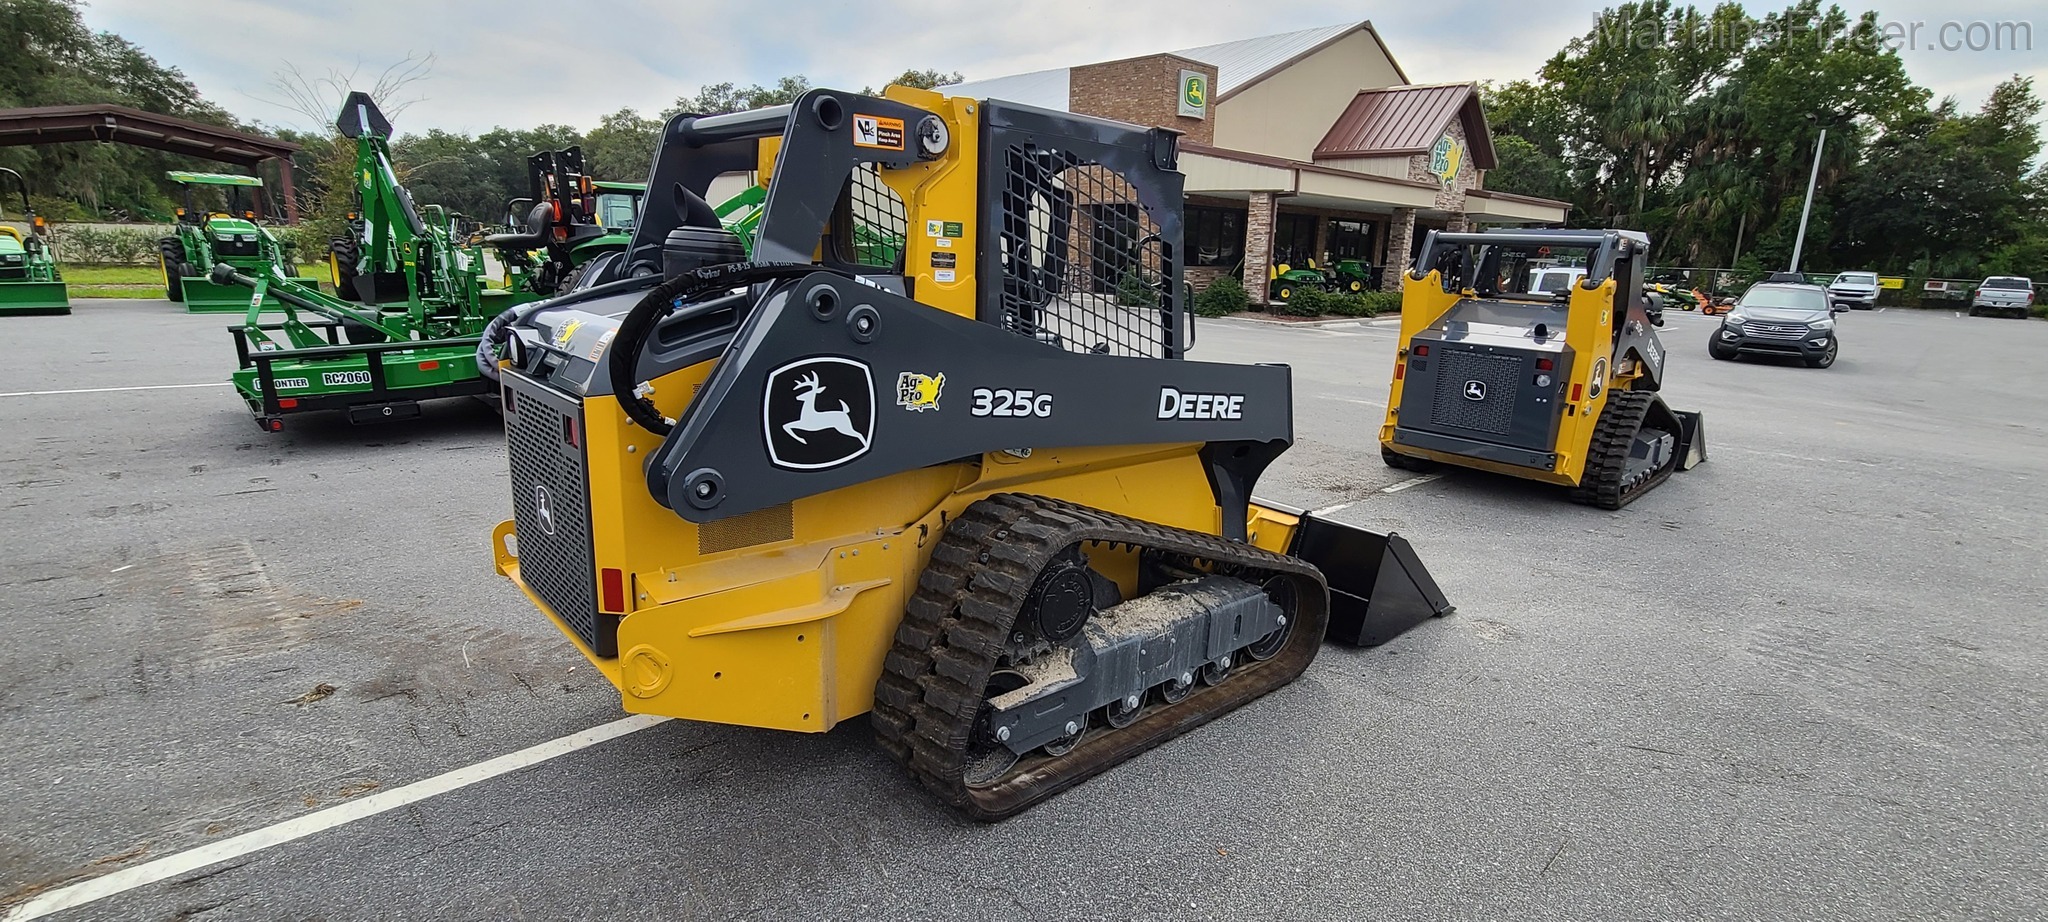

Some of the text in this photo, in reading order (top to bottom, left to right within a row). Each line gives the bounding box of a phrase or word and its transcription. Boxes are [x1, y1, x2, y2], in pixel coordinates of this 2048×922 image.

[1433, 153, 1448, 172] Pro
[324, 371, 371, 384] RC2060
[900, 375, 923, 391] Ag-
[900, 389, 922, 402] Pro
[971, 387, 1053, 417] 325G
[1158, 387, 1244, 419] DEERE
